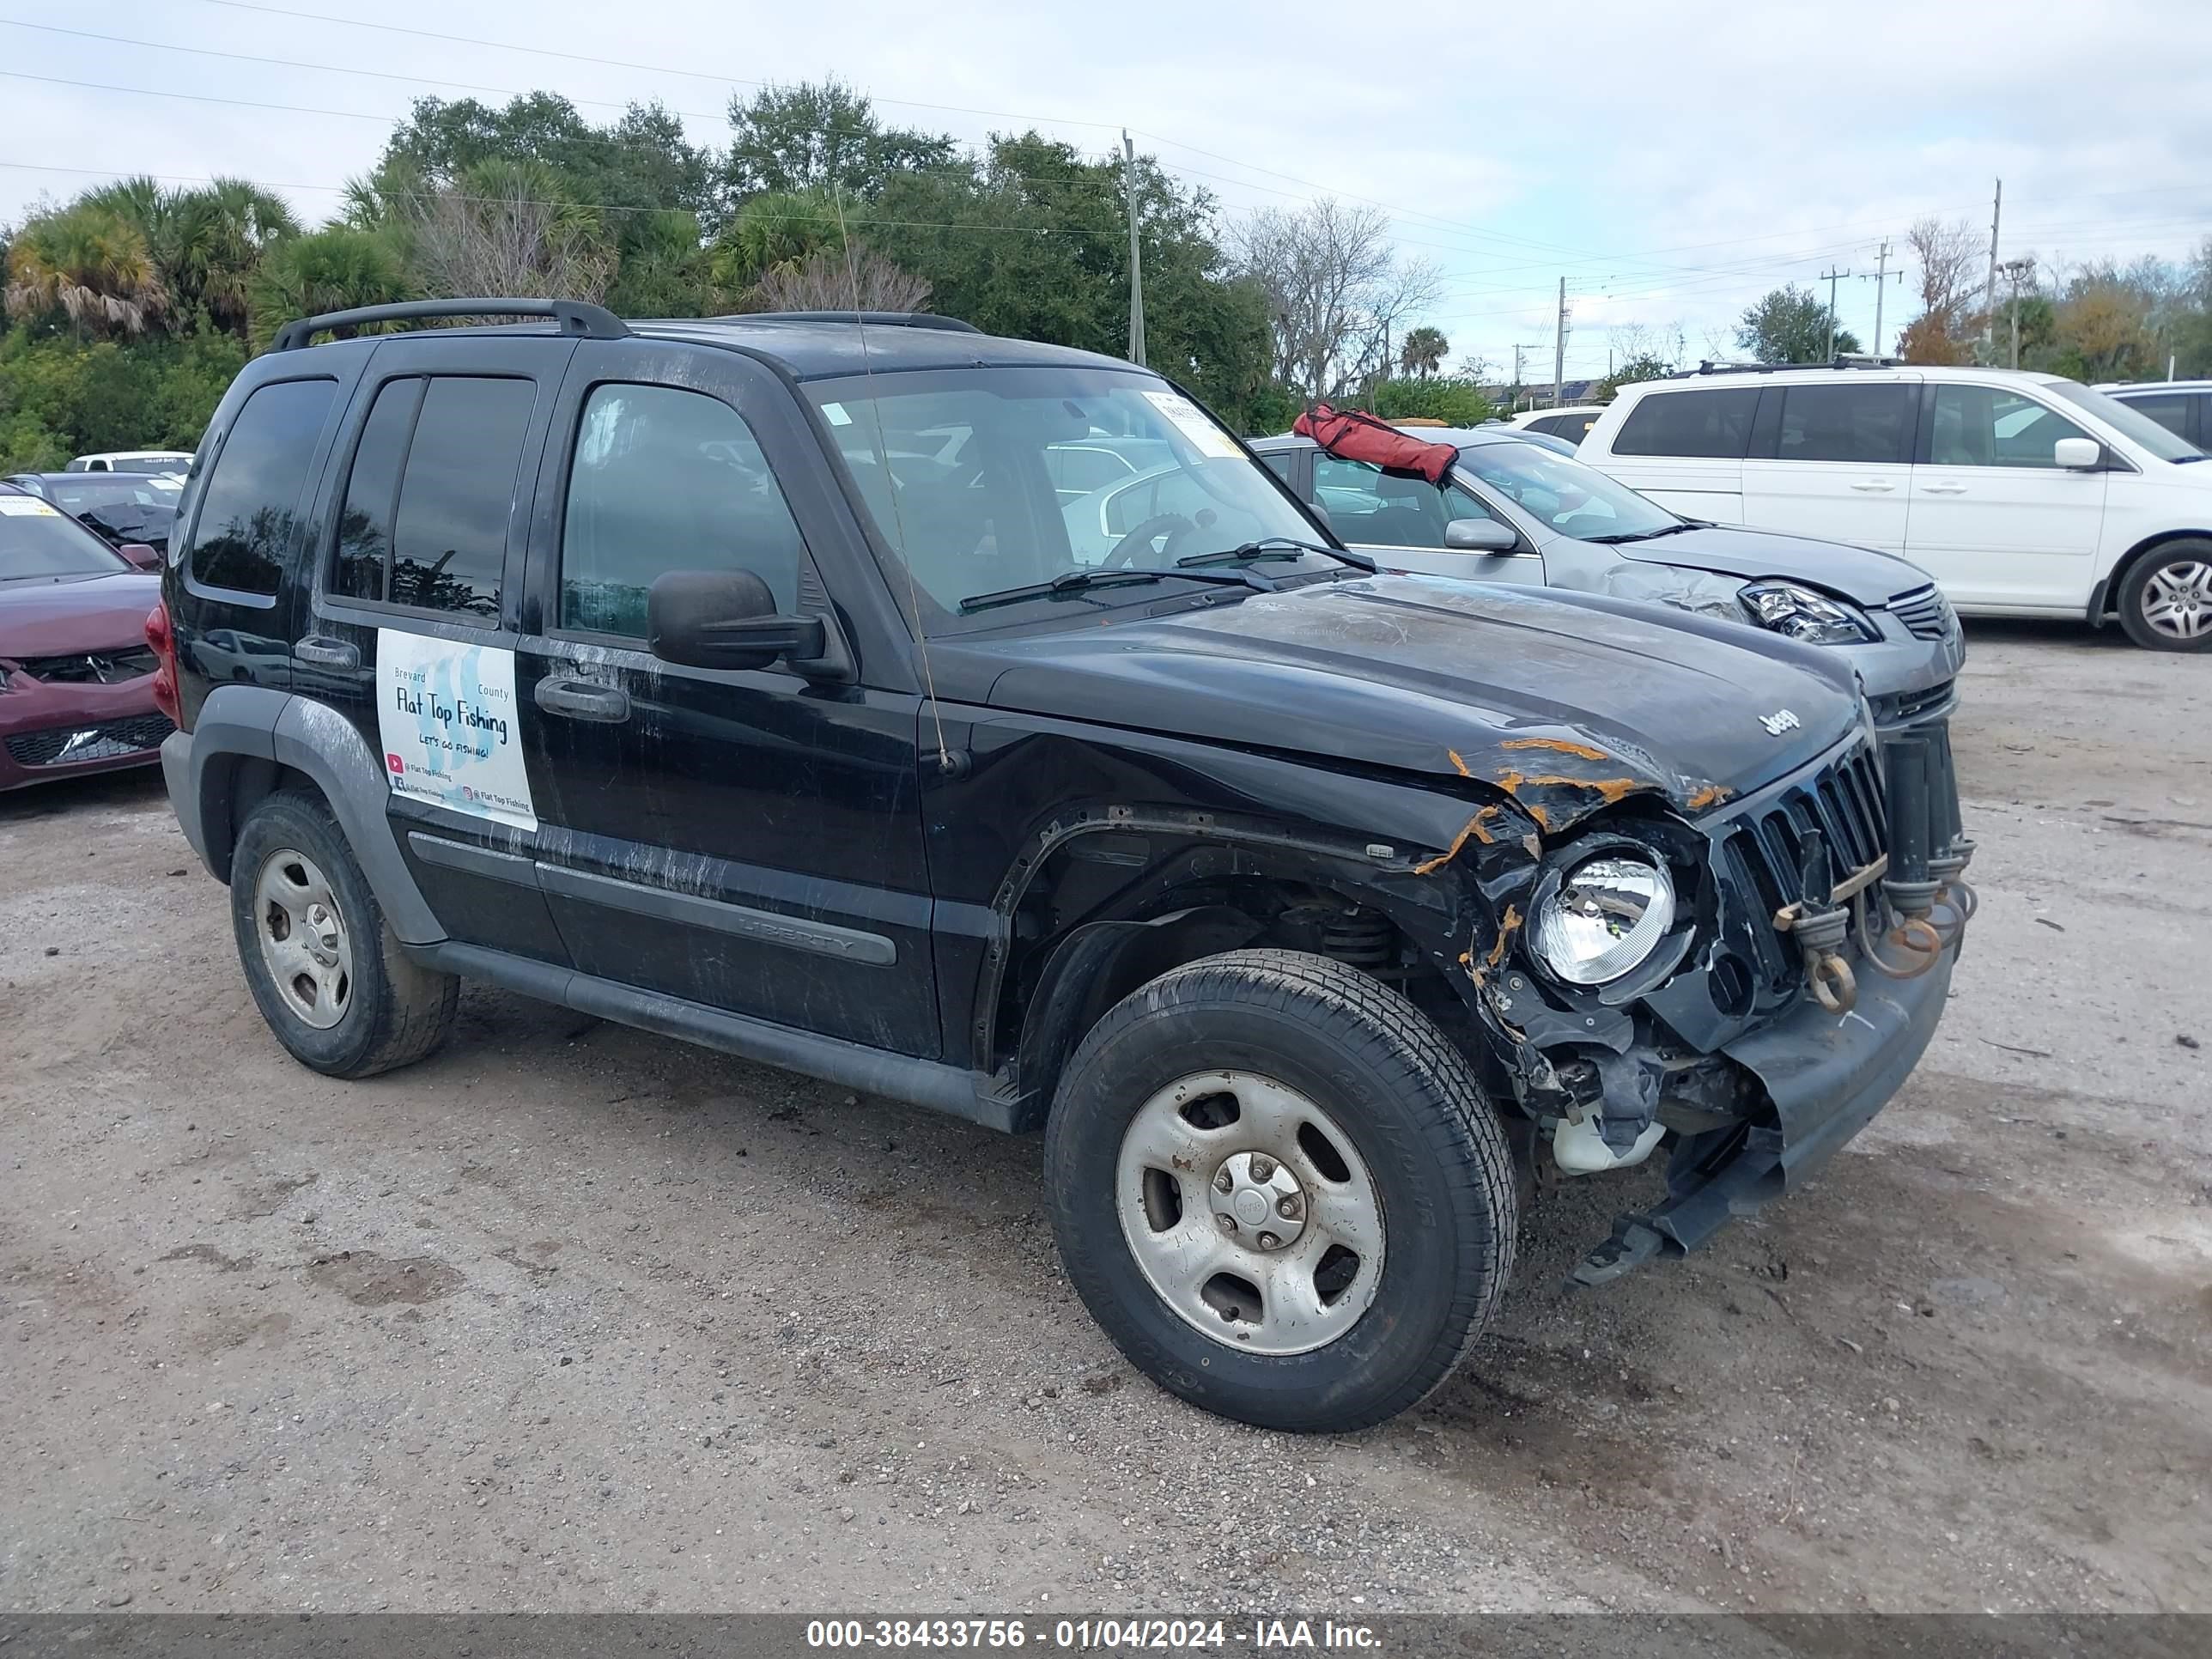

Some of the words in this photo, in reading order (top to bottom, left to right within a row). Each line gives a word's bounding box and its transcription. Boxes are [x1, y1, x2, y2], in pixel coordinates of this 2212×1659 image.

[394, 667, 426, 683] Brevard
[477, 684, 509, 702] County
[397, 687, 423, 715] Flat
[427, 692, 453, 729] Top
[457, 700, 507, 745] Fishing
[1757, 708, 1800, 736] Jeep
[419, 732, 439, 747] LET'S
[441, 740, 453, 750] GO
[455, 744, 489, 759] FISHING!
[410, 764, 421, 773] Flat
[422, 766, 431, 776] Top
[432, 769, 453, 782] Fishing
[481, 791, 493, 801] Flat
[494, 794, 506, 805] Top
[506, 798, 530, 812] Fishing
[738, 918, 855, 951] LIBERTY
